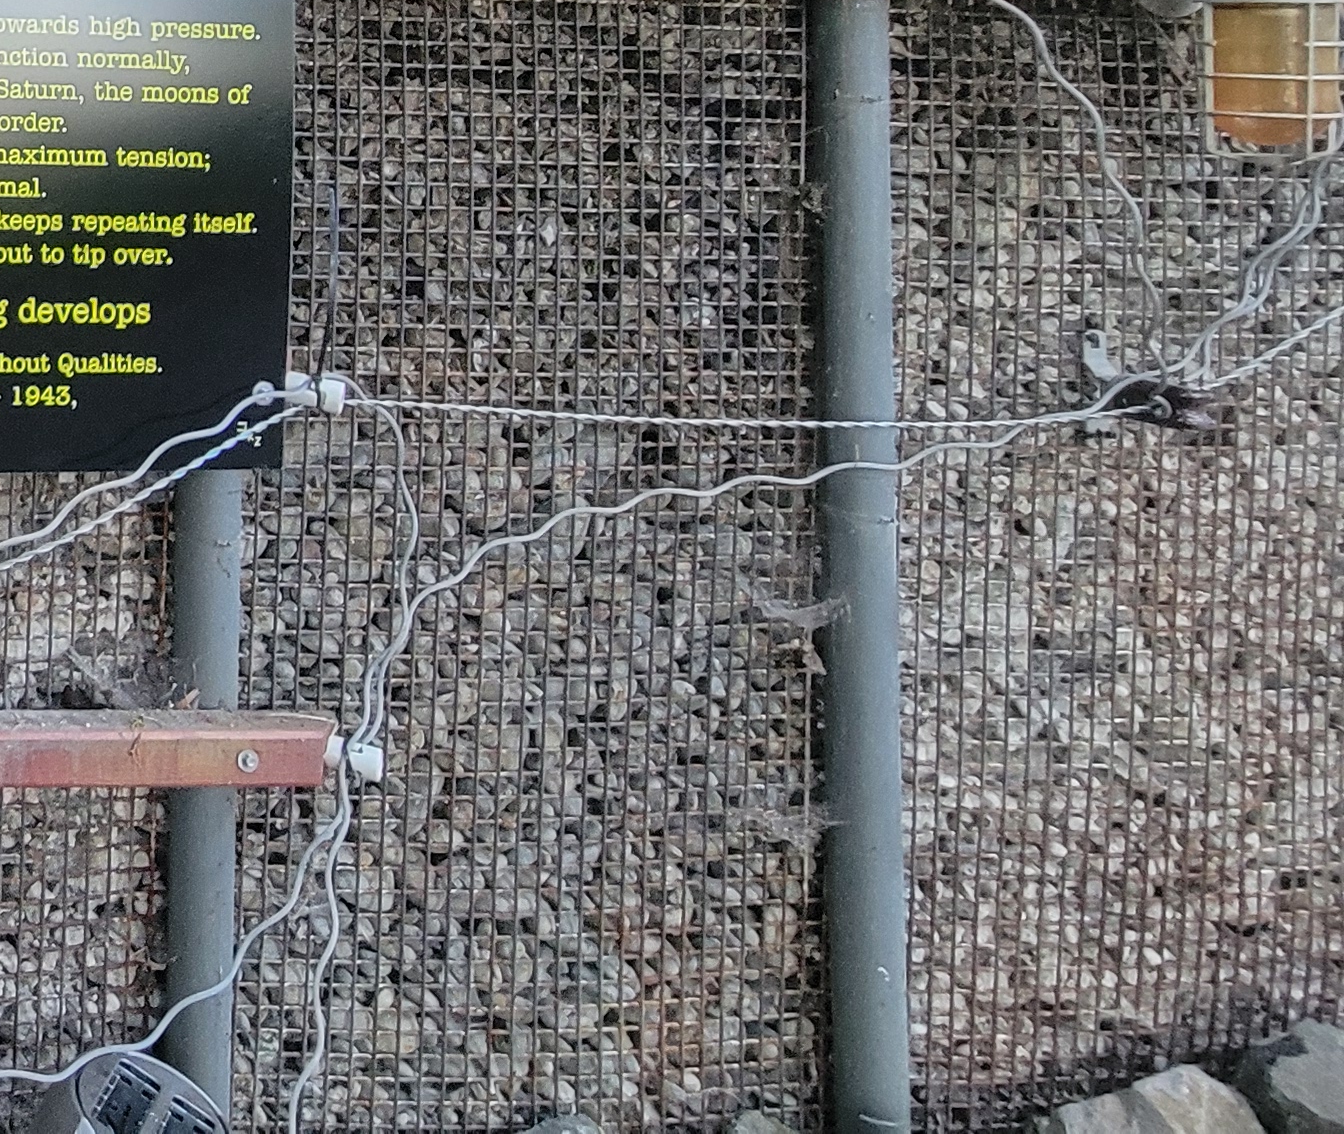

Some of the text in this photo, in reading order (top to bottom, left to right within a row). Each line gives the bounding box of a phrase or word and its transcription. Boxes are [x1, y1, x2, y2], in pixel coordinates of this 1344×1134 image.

[88, 15, 142, 41] high
[150, 21, 261, 42] pressure.
[76, 49, 190, 75] normally,
[94, 81, 133, 102] the
[141, 86, 220, 104] moons
[227, 84, 253, 105] of
[115, 146, 211, 173] tension;
[71, 211, 188, 238] repeating
[193, 212, 258, 234] itself.
[40, 243, 65, 265] to
[72, 243, 106, 269] tip
[113, 247, 174, 266] over.
[17, 296, 152, 330] develops
[57, 352, 163, 378] Qualities.
[12, 385, 78, 410] 1943,
